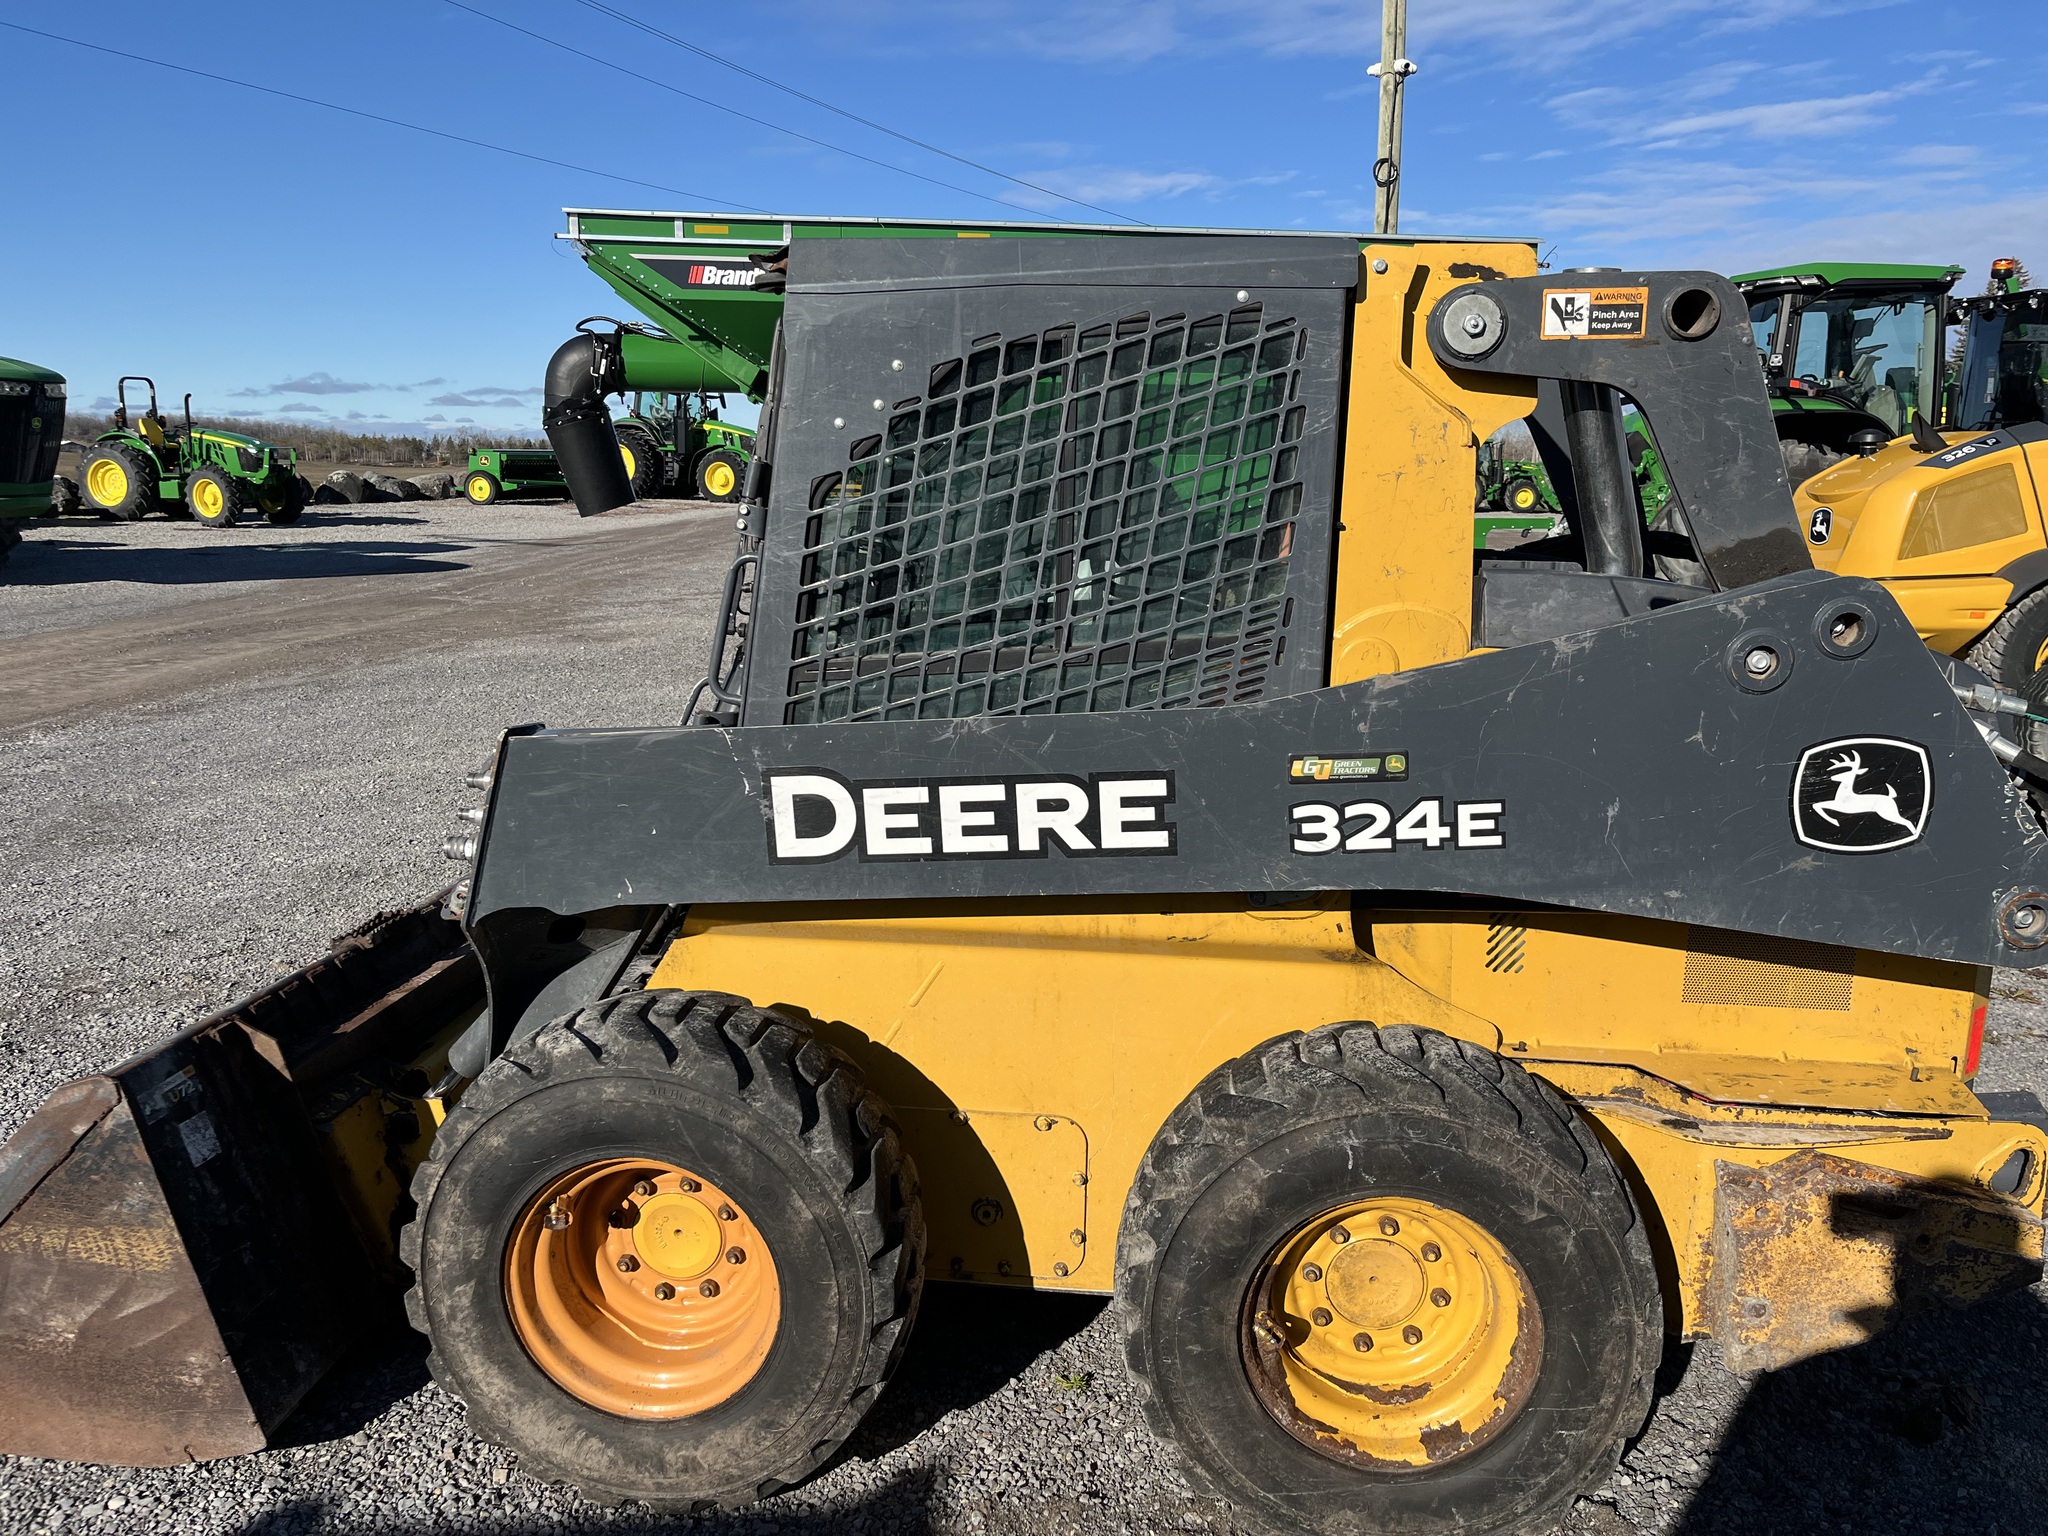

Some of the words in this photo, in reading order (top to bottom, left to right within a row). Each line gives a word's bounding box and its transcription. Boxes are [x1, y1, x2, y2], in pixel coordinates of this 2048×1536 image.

[701, 265, 766, 286] Brand
[1603, 292, 1642, 301] WARNING
[1592, 311, 1617, 319] Pinch
[1618, 310, 1640, 318] Area
[1591, 321, 1611, 330] Keep
[1611, 321, 1633, 330] Away
[1941, 445, 1976, 463] 326
[1303, 758, 1331, 778] GT
[1333, 760, 1362, 768] GREEN
[1333, 766, 1377, 774] TRACTORS
[769, 775, 1170, 859] DEERE
[1292, 799, 1503, 853] 324E
[1400, 1115, 1600, 1233] GALAXY
